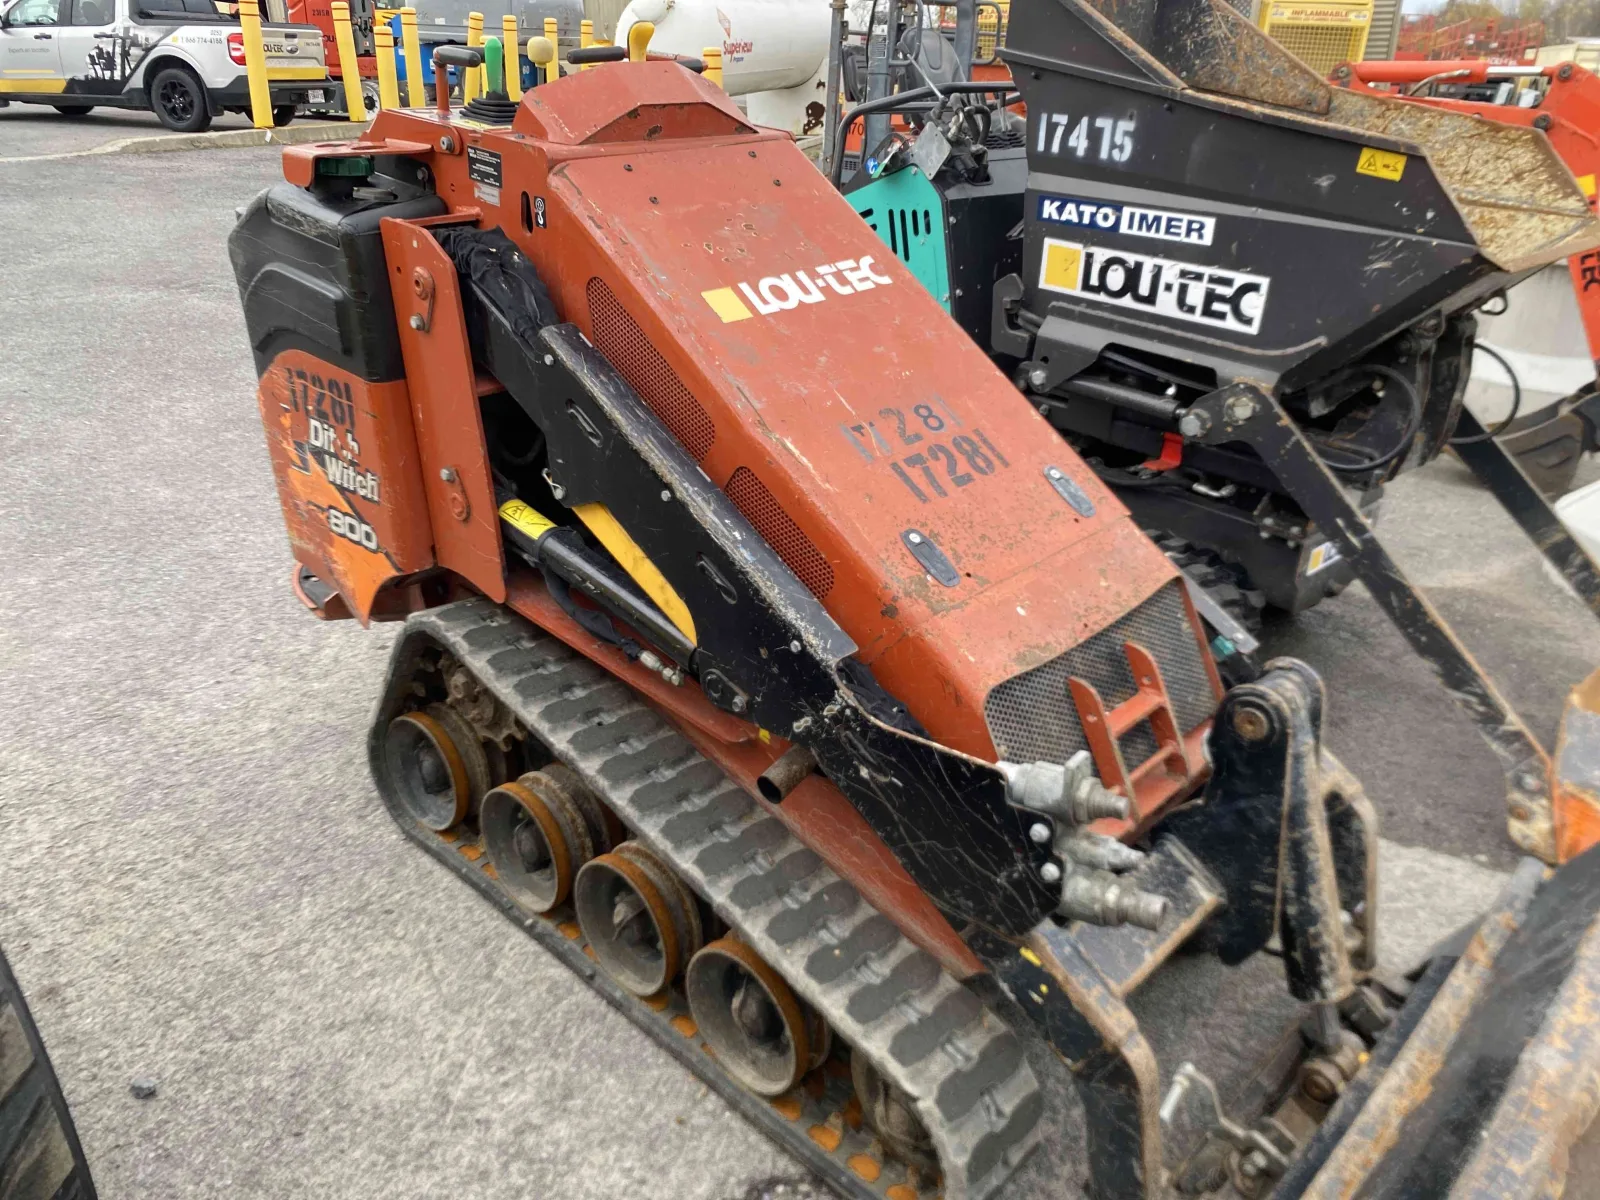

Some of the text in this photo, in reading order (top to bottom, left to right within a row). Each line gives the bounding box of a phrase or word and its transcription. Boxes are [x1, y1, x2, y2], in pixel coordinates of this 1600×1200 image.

[1291, 8, 1349, 17] INFLAMMABLE
[263, 44, 284, 53] OU-TEC
[1037, 112, 1136, 163] 17475
[1042, 198, 1207, 241] KATO IMER
[737, 254, 894, 316] LOU-TEC
[1080, 251, 1263, 328] LOU-TEC
[285, 367, 356, 430] 17281
[309, 418, 360, 461] Dith
[324, 454, 381, 502] Witch
[890, 428, 1010, 504] 17281
[328, 508, 379, 550] 800
